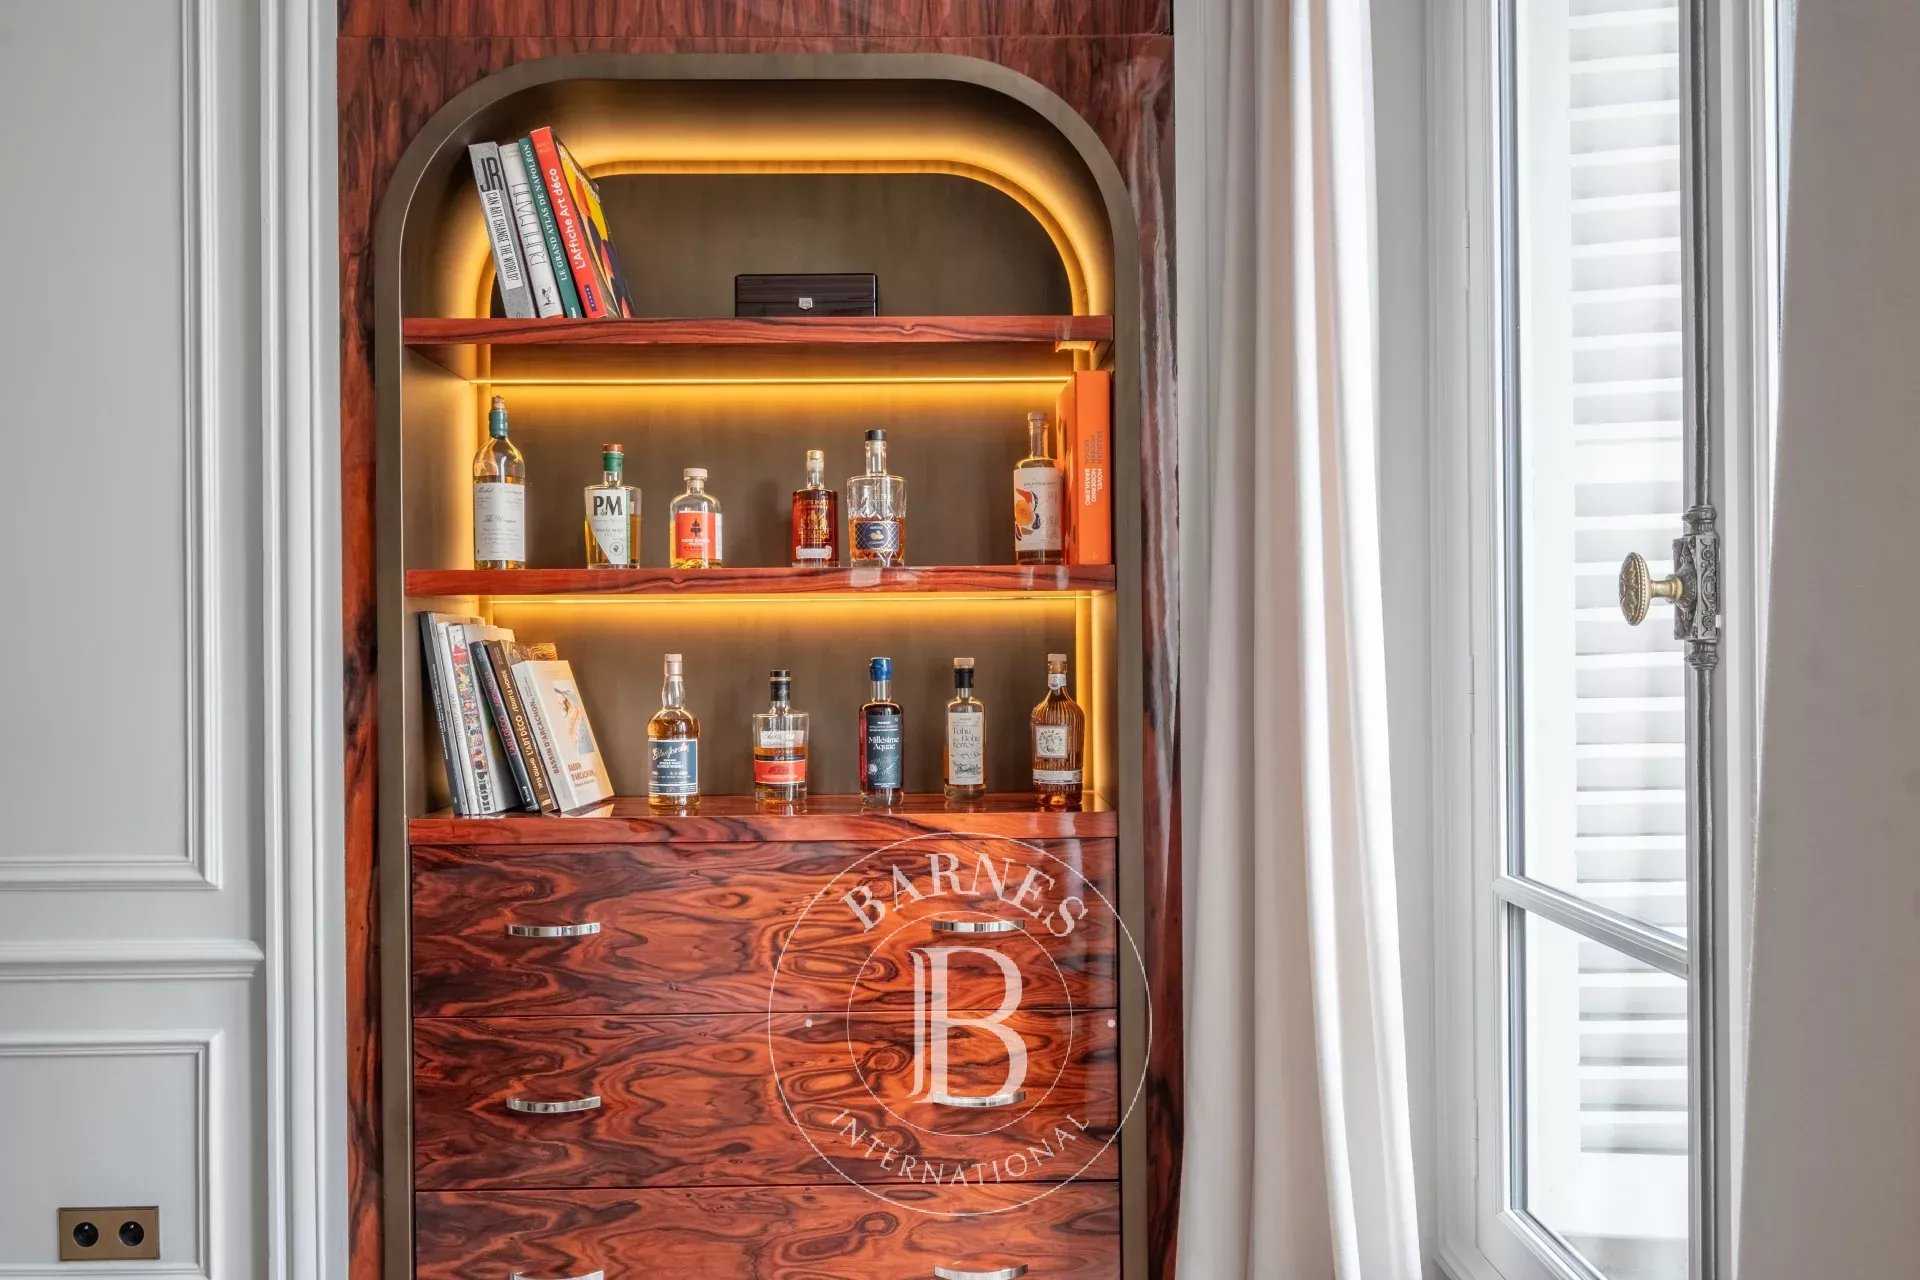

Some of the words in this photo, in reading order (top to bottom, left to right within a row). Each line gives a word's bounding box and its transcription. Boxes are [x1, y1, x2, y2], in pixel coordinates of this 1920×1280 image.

[480, 157, 502, 191] JR
[549, 168, 564, 195] déco
[486, 191, 499, 206] CAN
[537, 193, 546, 206] DE
[556, 196, 570, 217] Art
[489, 205, 503, 219] ART
[541, 207, 554, 234] ATLAS
[493, 218, 509, 243] CHANGE
[500, 243, 512, 257] THE
[550, 236, 564, 268] GRAND
[565, 219, 586, 269] L'Affiche
[558, 269, 568, 281] LE
[521, 735, 534, 756] L'ART
